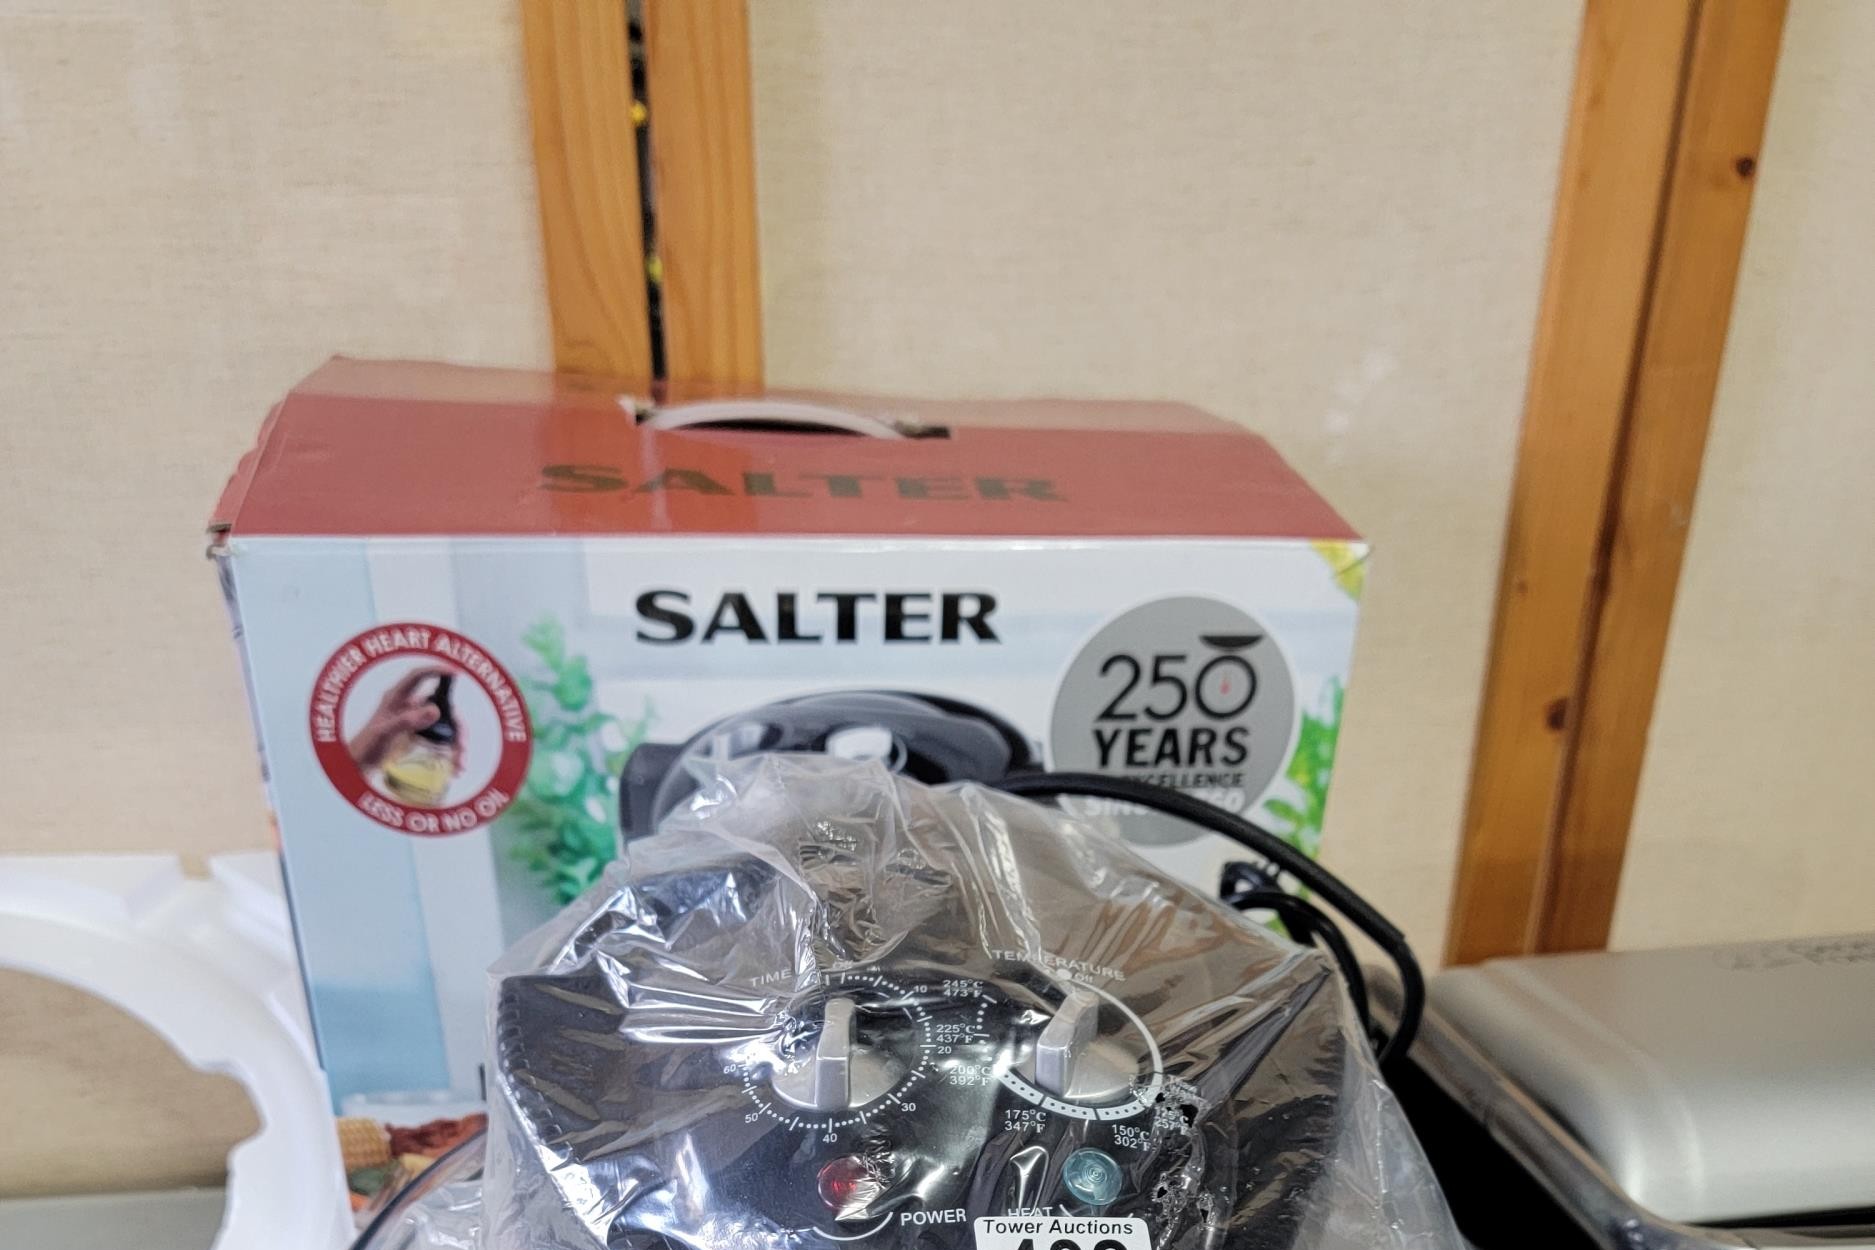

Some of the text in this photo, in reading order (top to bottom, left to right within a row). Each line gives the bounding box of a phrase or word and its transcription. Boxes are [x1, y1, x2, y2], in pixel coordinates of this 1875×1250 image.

[539, 464, 1068, 500] SALTER
[635, 590, 1001, 644] SALTER
[317, 629, 527, 742] HEALTHIER HEART ALTERNATIVE
[1097, 654, 1257, 722] 250
[1093, 726, 1250, 768] YEARS
[357, 788, 510, 833] LESS OR NO OIL
[750, 967, 793, 987] TIME
[912, 985, 928, 993] 10
[936, 1023, 976, 1034] 225°C
[936, 1033, 975, 1044] 437°F
[937, 1046, 952, 1054] 20
[723, 1064, 737, 1074] 60
[949, 1065, 992, 1076] 200°C
[949, 1075, 991, 1086] 392°F
[901, 1103, 917, 1112] 30
[744, 1113, 759, 1124] 50
[1005, 1110, 1047, 1122] 175°C
[1004, 1121, 1046, 1133] 347°F
[1111, 1124, 1150, 1141] 150°C
[822, 1133, 838, 1143] 40
[1114, 1134, 1152, 1152] 302°F
[901, 1208, 967, 1226] POWER
[983, 1219, 1134, 1235] Tower Auctions
